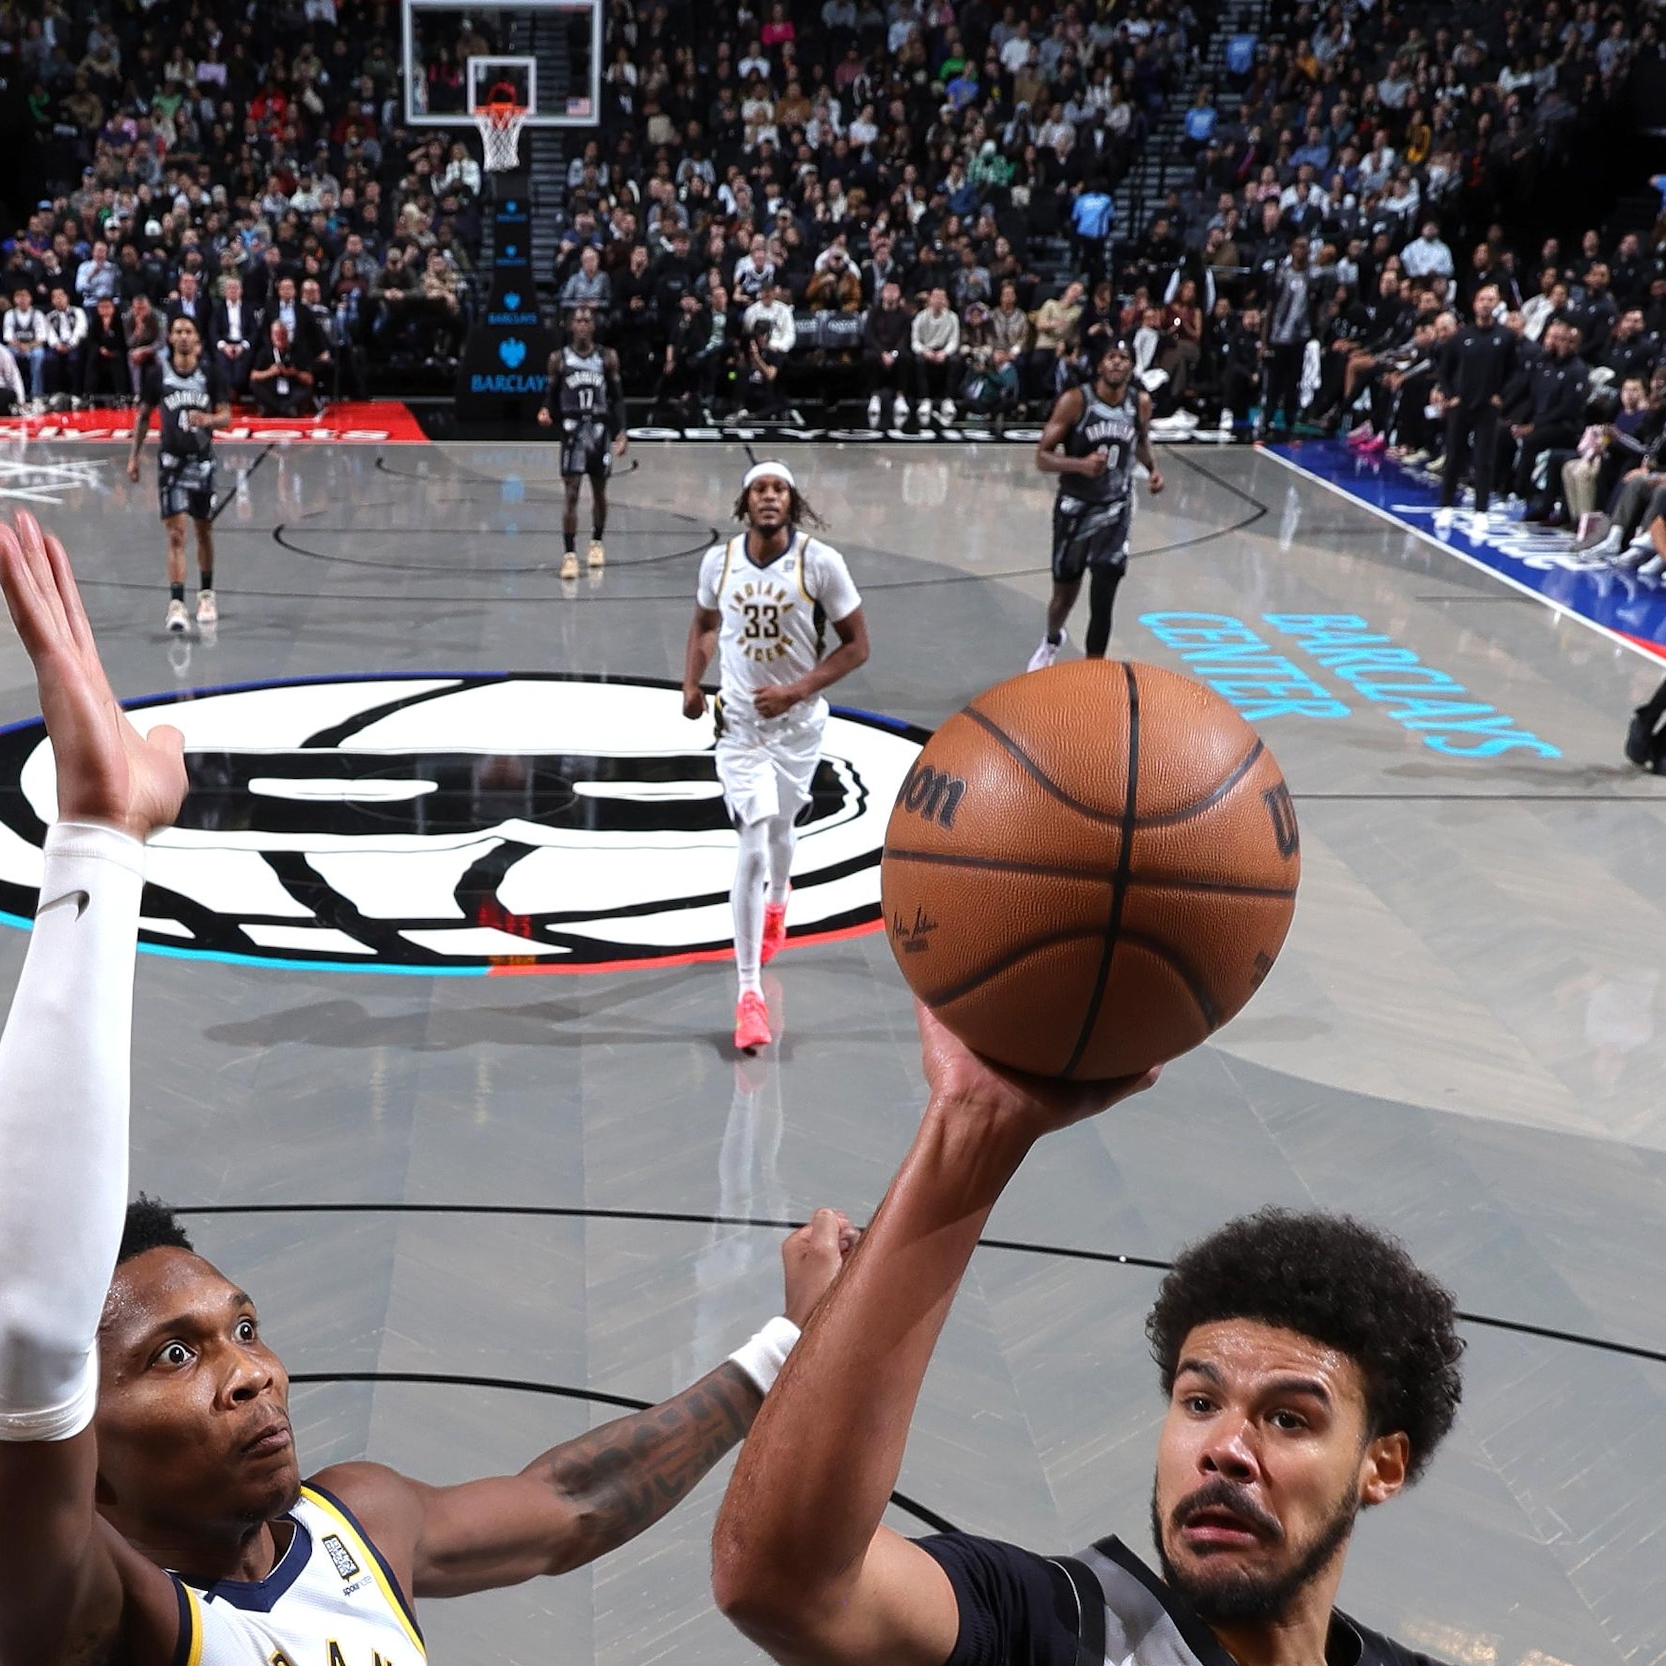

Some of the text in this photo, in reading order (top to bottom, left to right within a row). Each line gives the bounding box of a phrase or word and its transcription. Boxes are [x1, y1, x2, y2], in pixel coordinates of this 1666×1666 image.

[744, 605, 780, 638] 33
[1138, 611, 1352, 722] CENTER
[1261, 613, 1563, 760] BARCLAYS
